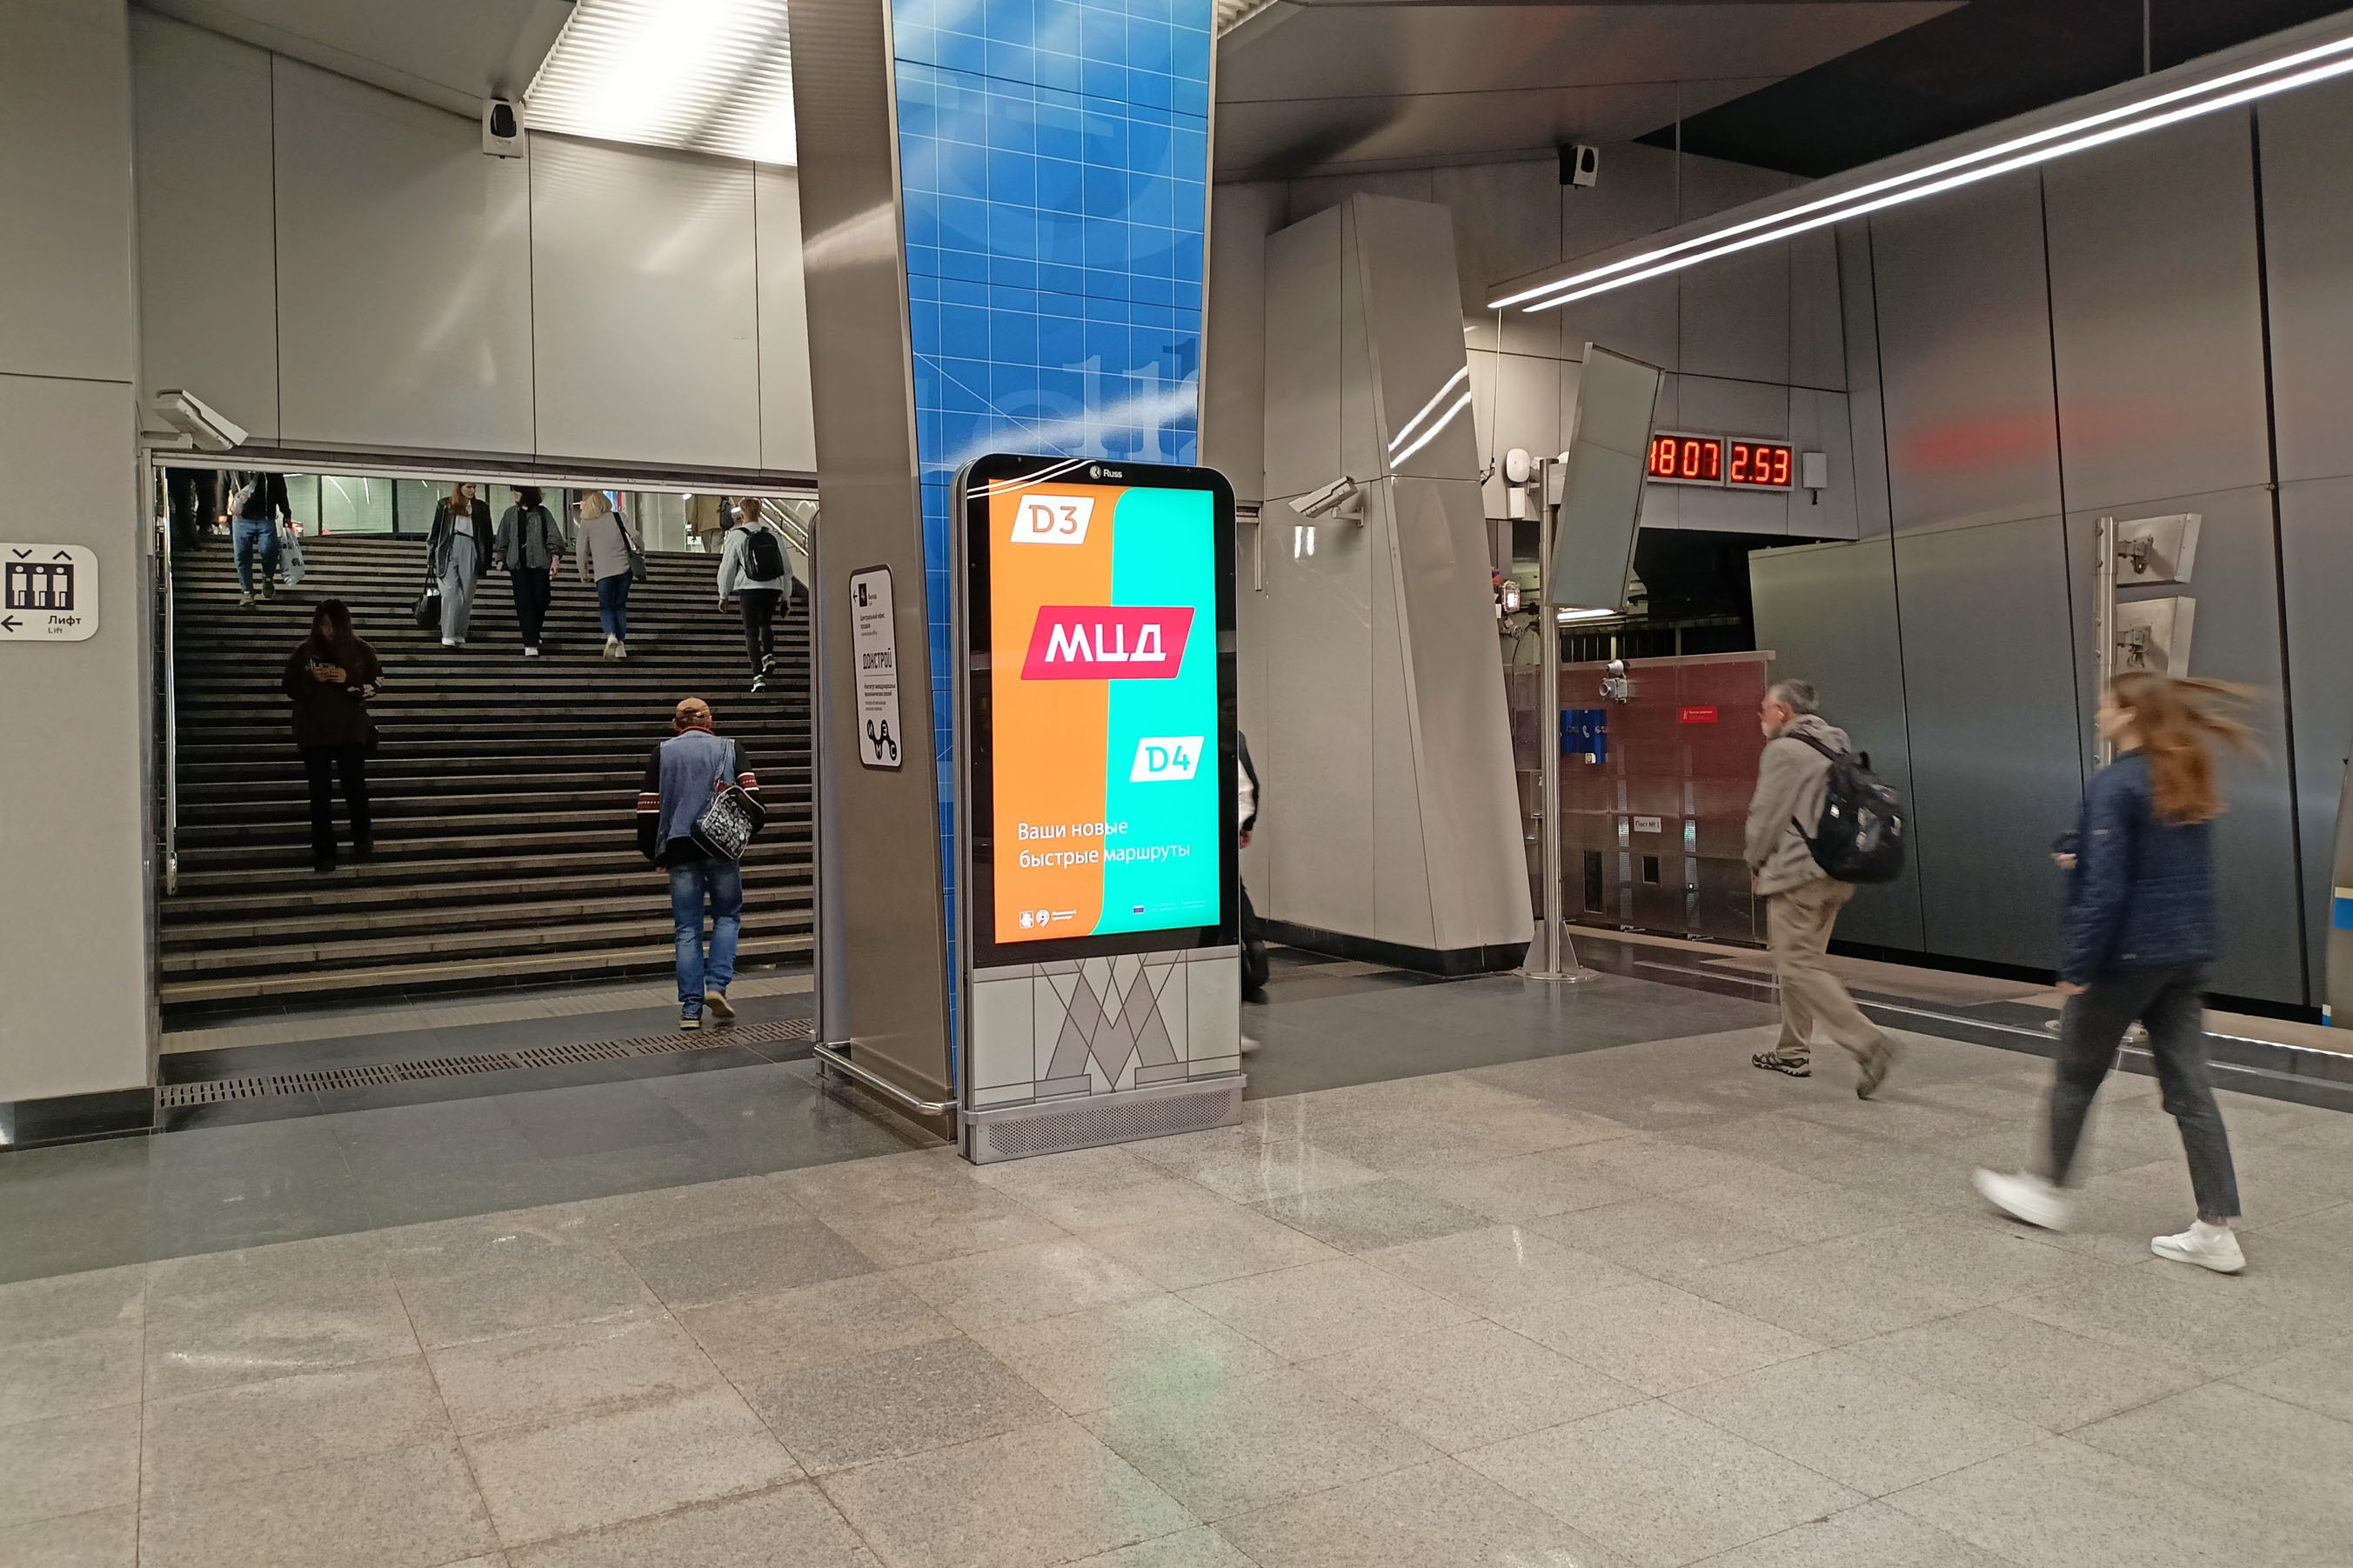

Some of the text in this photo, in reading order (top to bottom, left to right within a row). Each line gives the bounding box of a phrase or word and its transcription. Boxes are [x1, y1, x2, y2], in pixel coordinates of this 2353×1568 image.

[1103, 468, 1123, 478] Russ
[1731, 445, 1788, 483] 2.53
[1028, 504, 1078, 535] D3
[48, 615, 82, 626] Лифт
[1045, 624, 1166, 663] МЦД
[863, 647, 892, 670] ДОНСТРОЙ
[1145, 745, 1190, 771] D4
[1018, 821, 1128, 840] Ваши новые
[1019, 844, 1191, 869] быстрые маршруты
